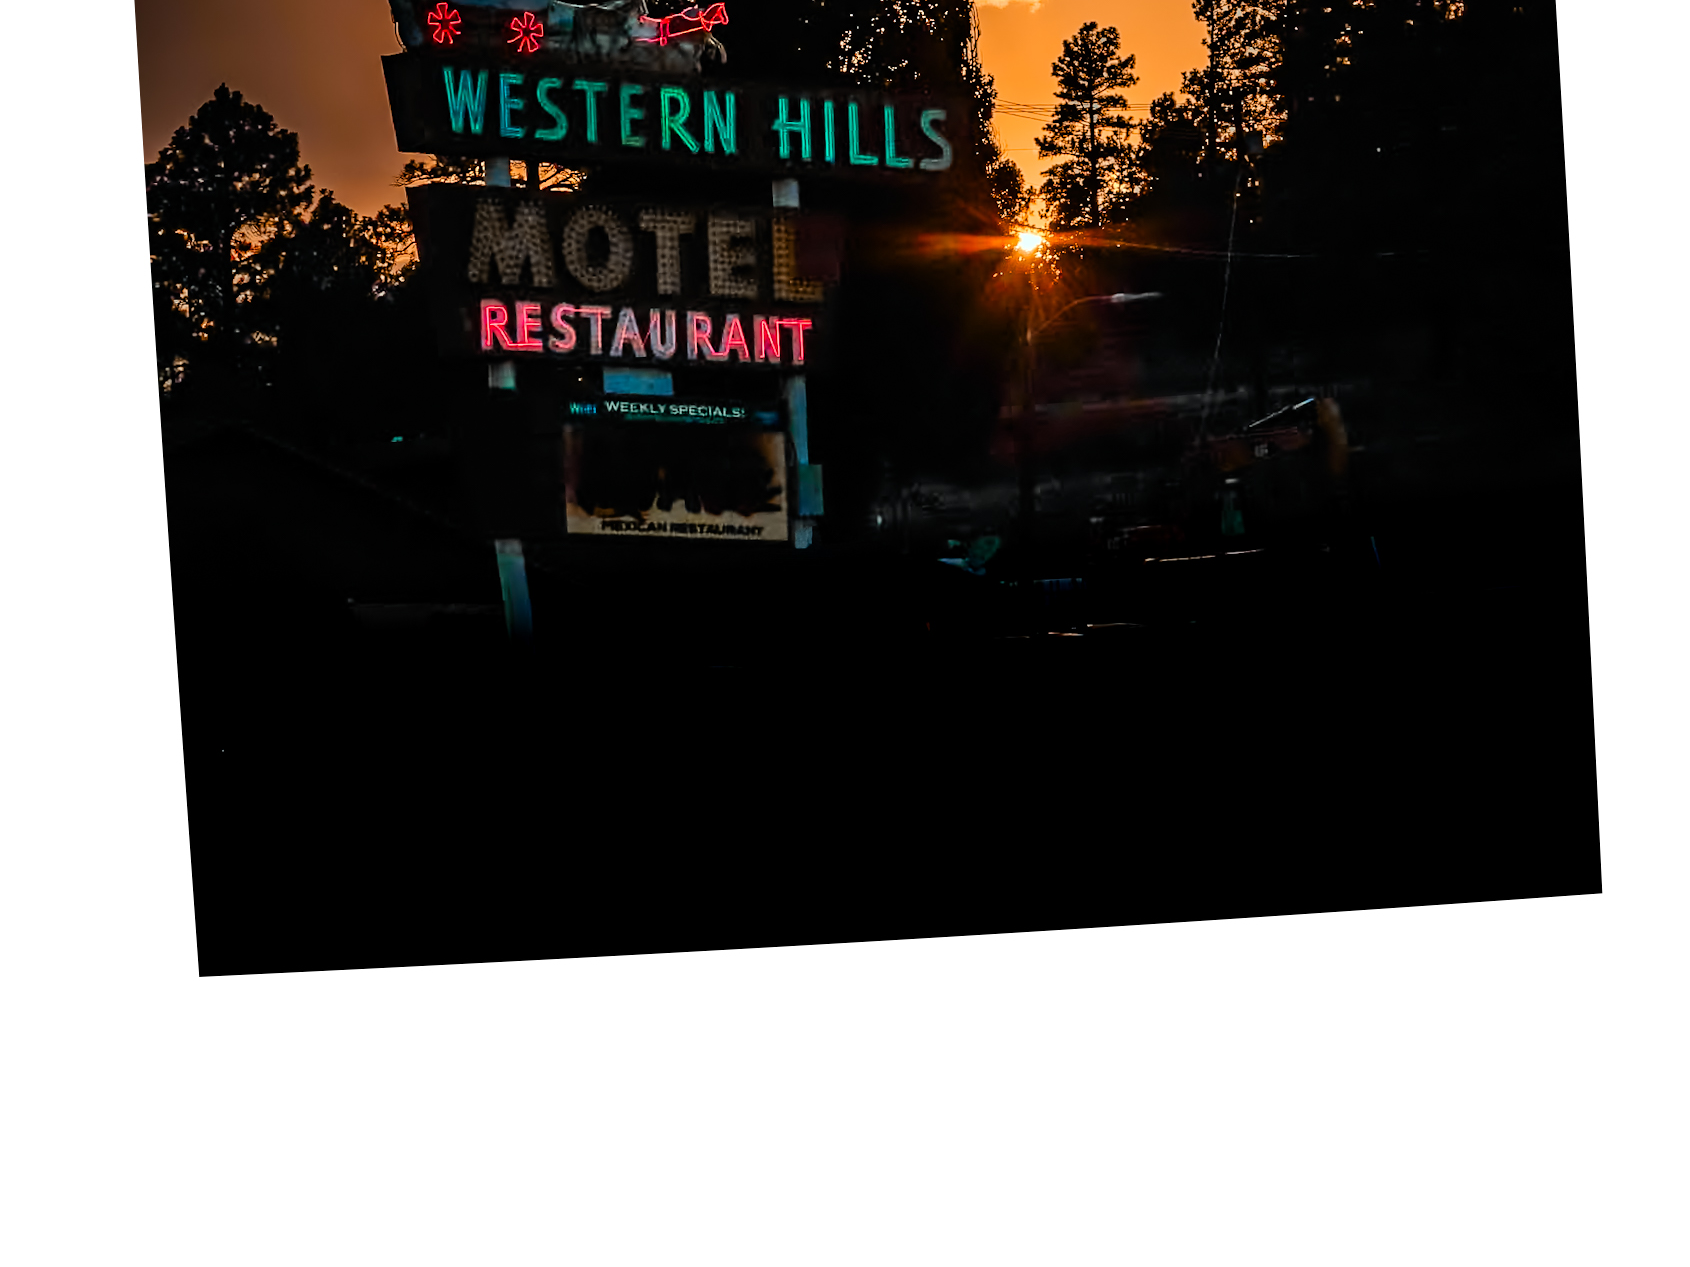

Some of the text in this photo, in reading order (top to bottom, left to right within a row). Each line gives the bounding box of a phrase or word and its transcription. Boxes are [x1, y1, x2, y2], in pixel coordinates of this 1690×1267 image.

[442, 66, 954, 171] WESTERN HILLS
[467, 200, 824, 302] MOTEL
[480, 299, 812, 364] RESTAURANT
[605, 400, 746, 418] WEEKLY SPECIALS!
[602, 519, 764, 535] MEXICAN RESTAURANT
